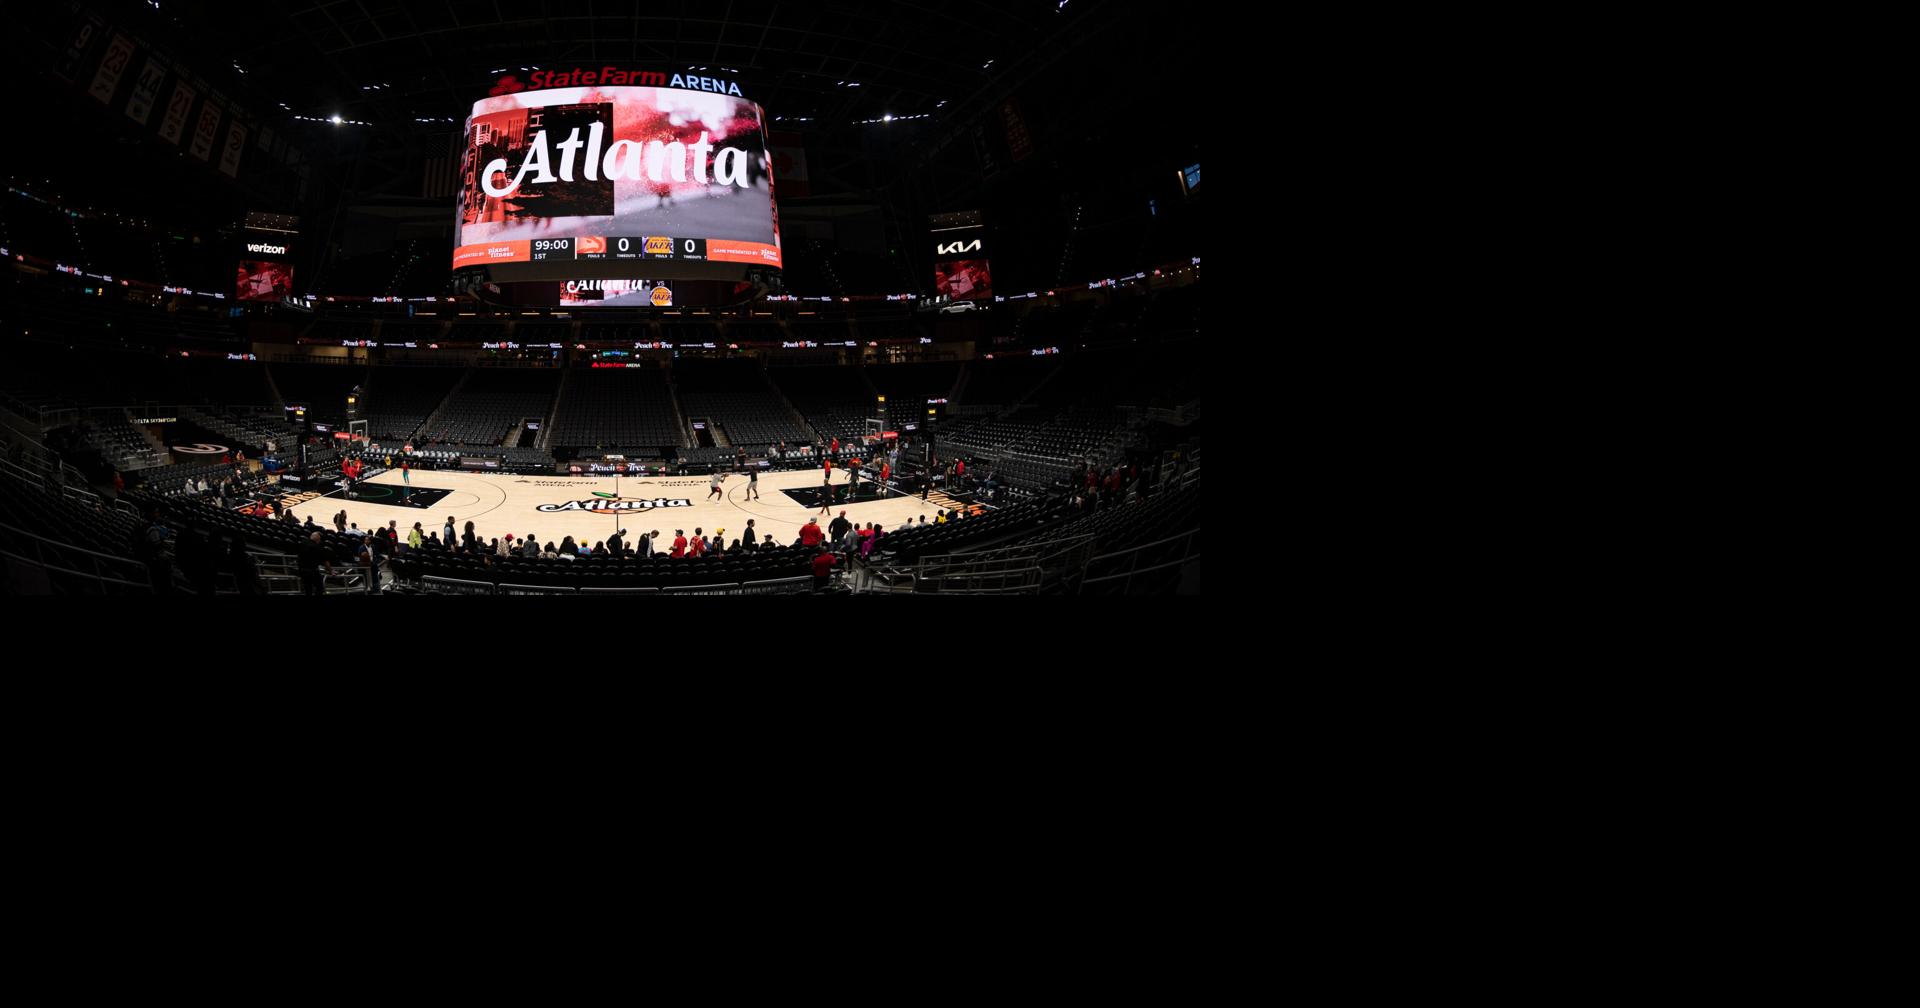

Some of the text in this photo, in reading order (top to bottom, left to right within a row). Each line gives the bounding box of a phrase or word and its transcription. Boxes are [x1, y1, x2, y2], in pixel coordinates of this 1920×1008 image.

[103, 45, 129, 75] 23
[527, 66, 743, 97] State Farm ARENA
[481, 121, 751, 198] Atlanta
[247, 243, 286, 255] verizon
[535, 239, 569, 251] 99:00
[618, 238, 629, 252] 0
[684, 240, 696, 253] 0
[937, 239, 982, 255] KIA
[633, 341, 652, 349] Peach
[660, 341, 673, 349] Tree
[590, 462, 646, 472] Peach Tree
[536, 498, 694, 513] Atlanta
